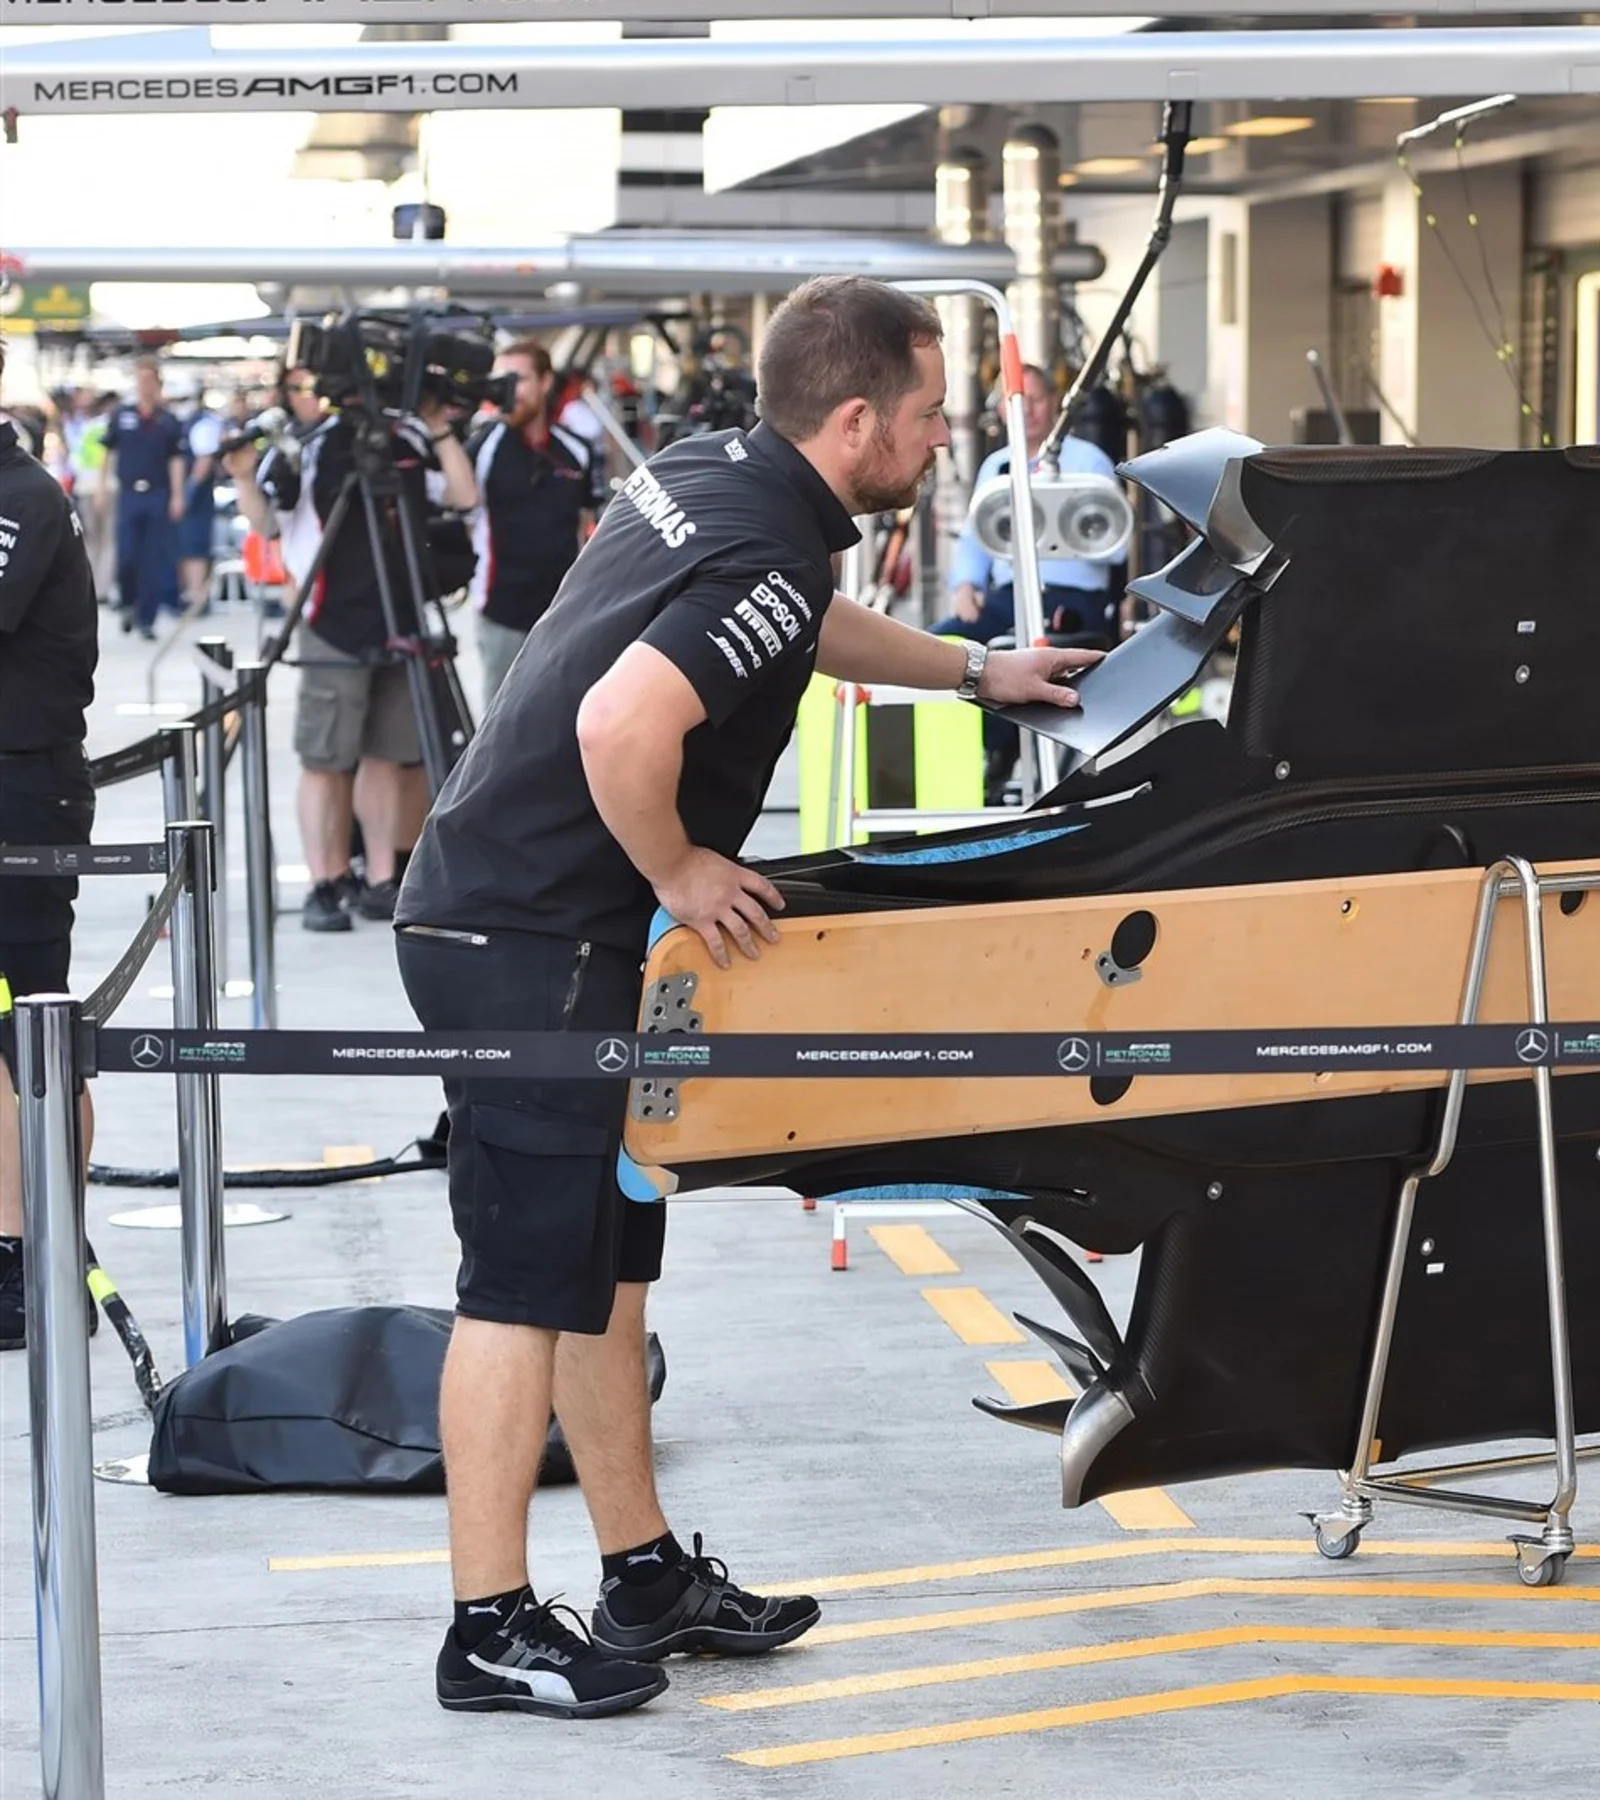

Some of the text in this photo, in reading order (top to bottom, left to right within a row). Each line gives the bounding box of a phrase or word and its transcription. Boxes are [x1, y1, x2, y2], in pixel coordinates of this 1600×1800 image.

[750, 583, 802, 642] EPSON
[179, 1048, 246, 1057] PETRONAS
[643, 1051, 711, 1060] PETRONAS
[1104, 1049, 1172, 1058] PETRONAS
